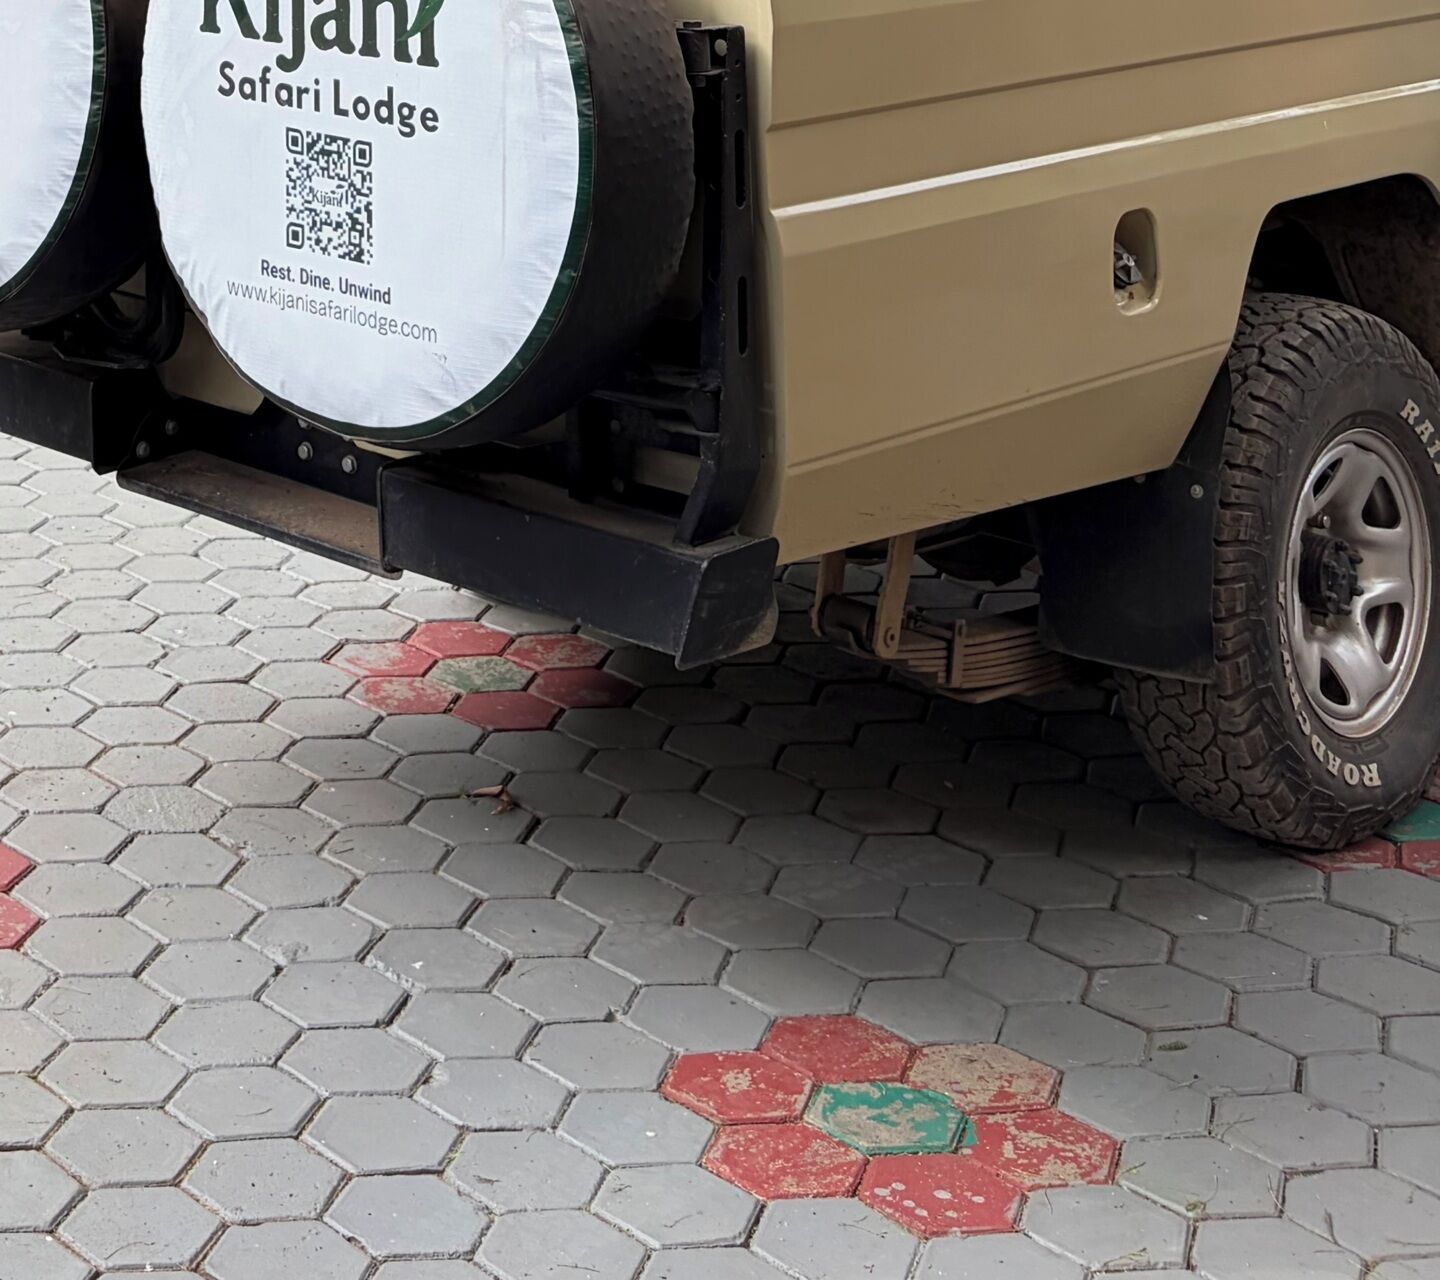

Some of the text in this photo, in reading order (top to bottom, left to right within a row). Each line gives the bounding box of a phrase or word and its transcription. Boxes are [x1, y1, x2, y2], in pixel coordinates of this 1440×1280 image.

[217, 60, 440, 138] Safari Lodge
[226, 280, 438, 344] www.kijanisafarilodge.com
[260, 258, 392, 305] Rest. Dine. Unwind
